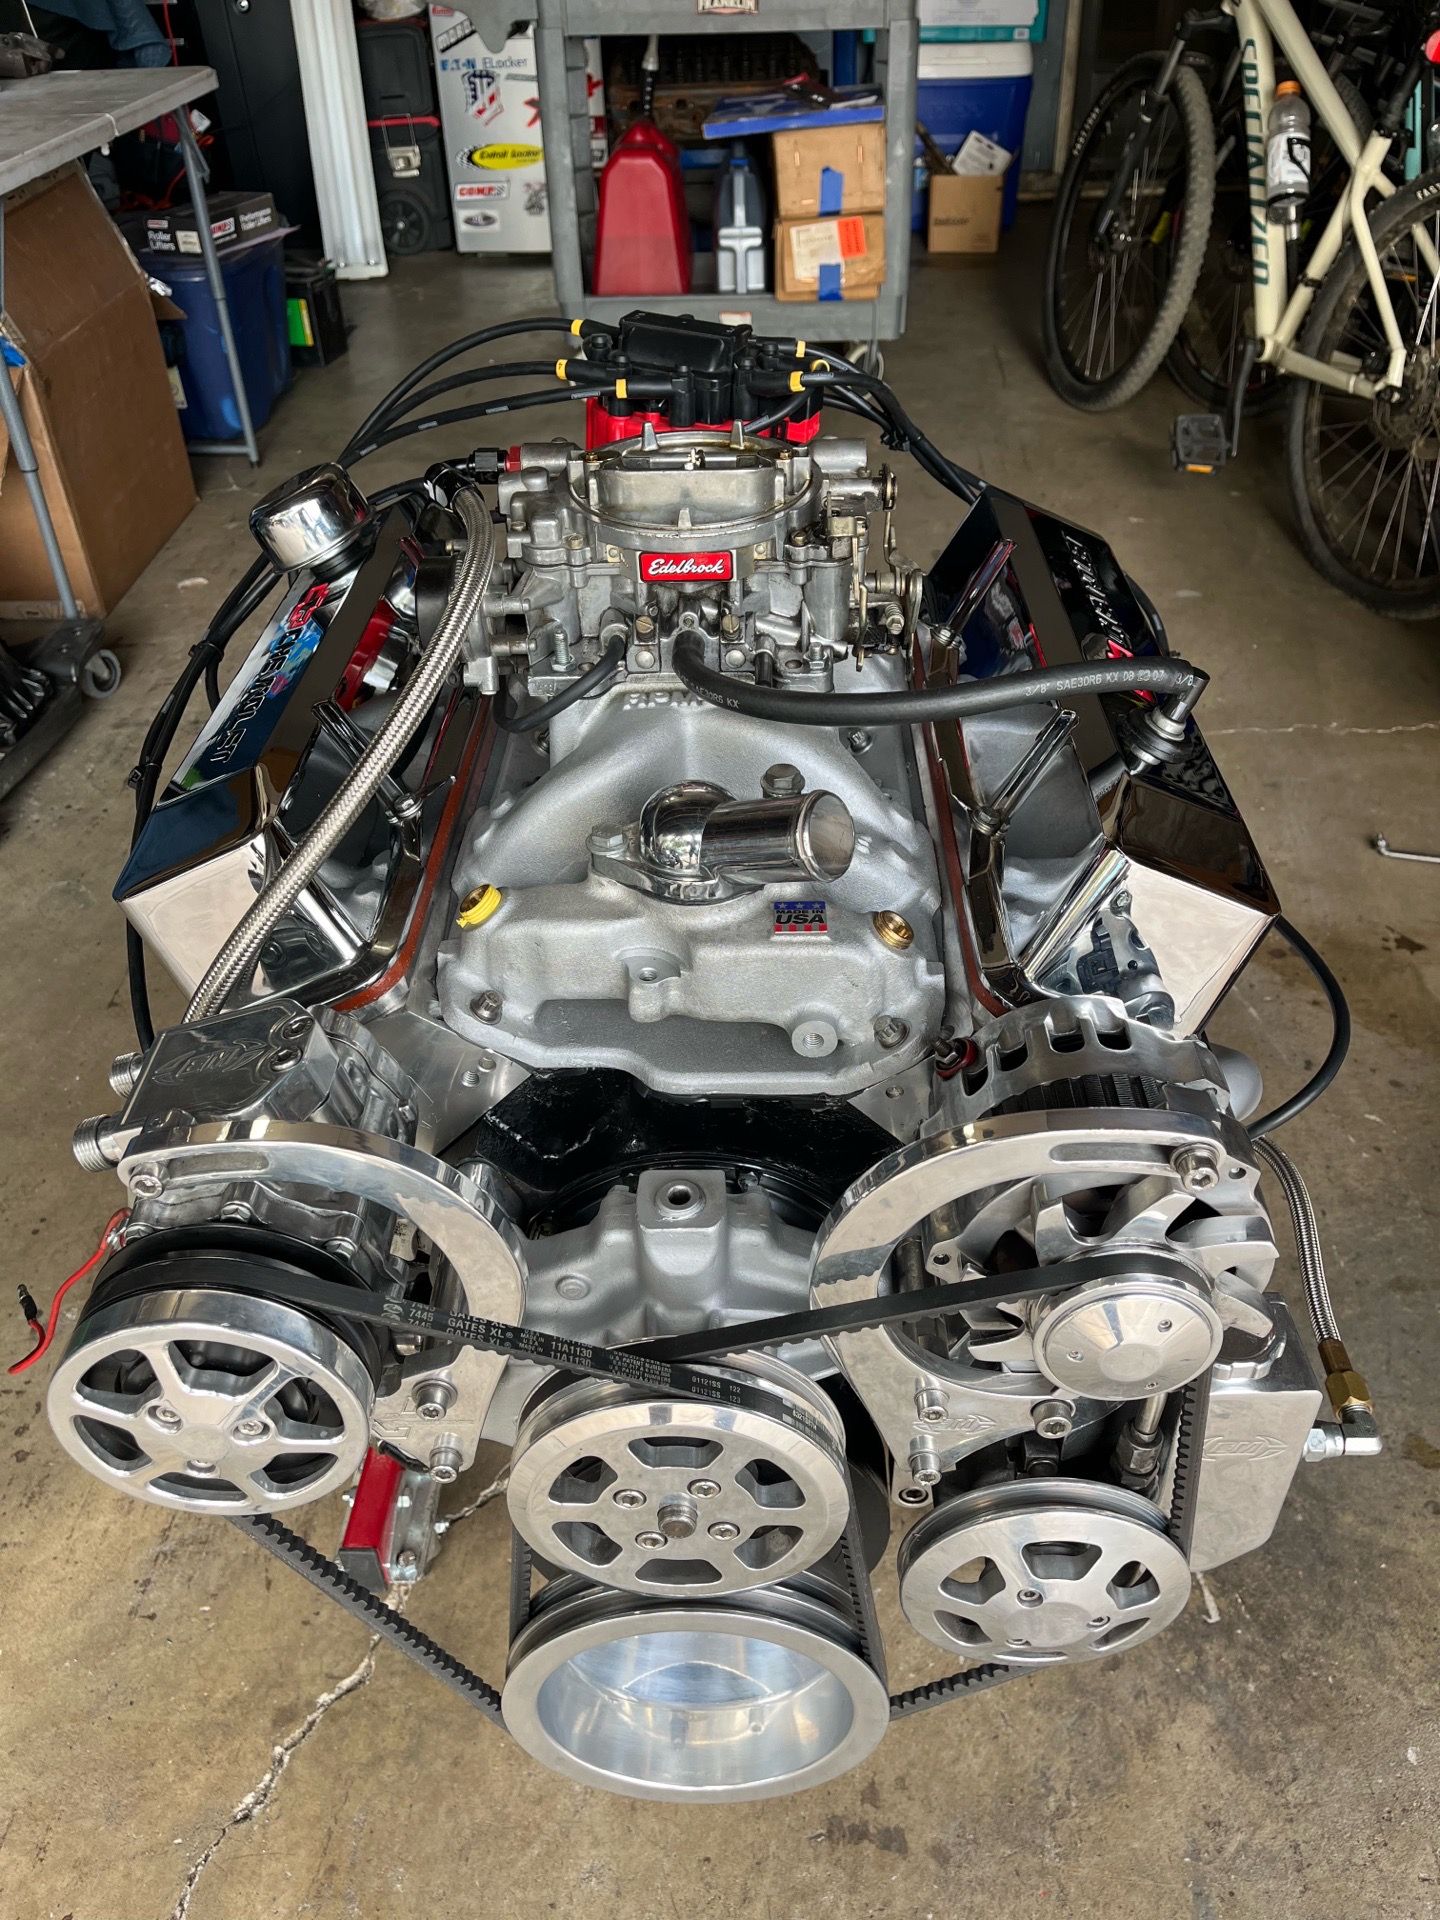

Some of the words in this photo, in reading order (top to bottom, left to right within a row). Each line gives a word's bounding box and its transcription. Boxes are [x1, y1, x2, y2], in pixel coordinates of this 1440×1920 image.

[147, 231, 171, 242] Roller
[648, 558, 724, 575] Edelbrock
[775, 914, 825, 924] USA
[409, 1308, 434, 1322] 7445
[448, 1318, 486, 1334] GATES
[550, 1341, 593, 1358] 11A1130
